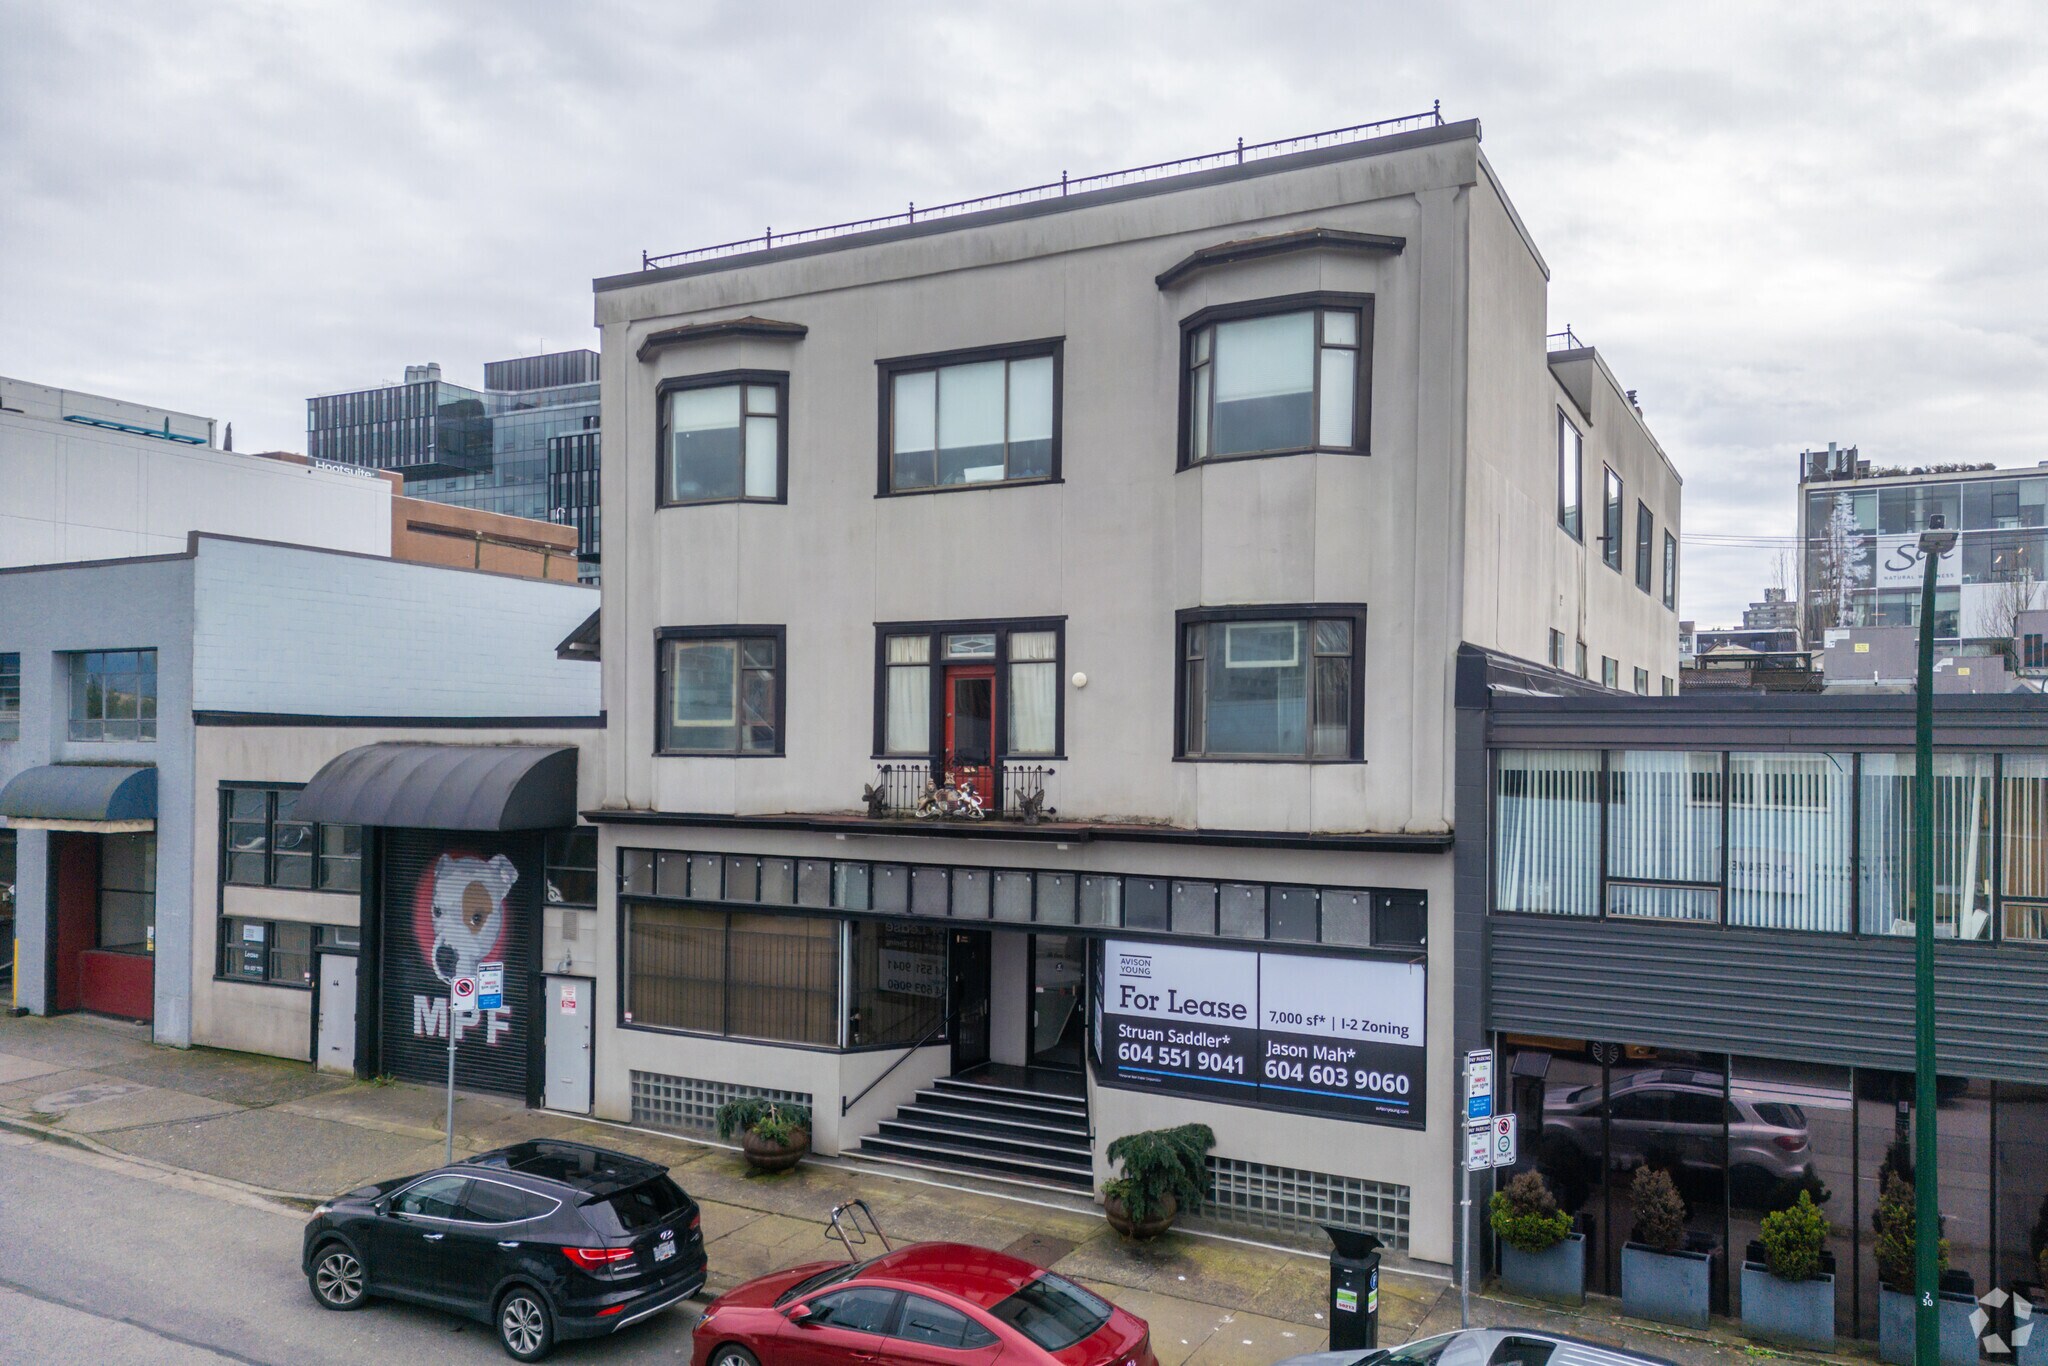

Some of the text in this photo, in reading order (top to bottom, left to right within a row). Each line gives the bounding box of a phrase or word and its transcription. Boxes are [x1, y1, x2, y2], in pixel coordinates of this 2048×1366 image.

[315, 460, 372, 478] Hootsuite
[1120, 957, 1151, 967] AVISON
[1120, 966, 1151, 976] YOUNG
[1119, 984, 1248, 1021] For Lease
[1118, 1024, 1164, 1042] Struan
[1269, 1010, 1303, 1026] 7,000
[1341, 1018, 1358, 1031] I-2
[1361, 1020, 1410, 1039] Zoning
[1266, 1040, 1308, 1058] Jason
[1118, 1042, 1244, 1075] 604 551 9041
[1265, 1060, 1410, 1095] 604 603 9060
[1922, 1299, 1934, 1307] 50
[1925, 1291, 1930, 1299] 2
